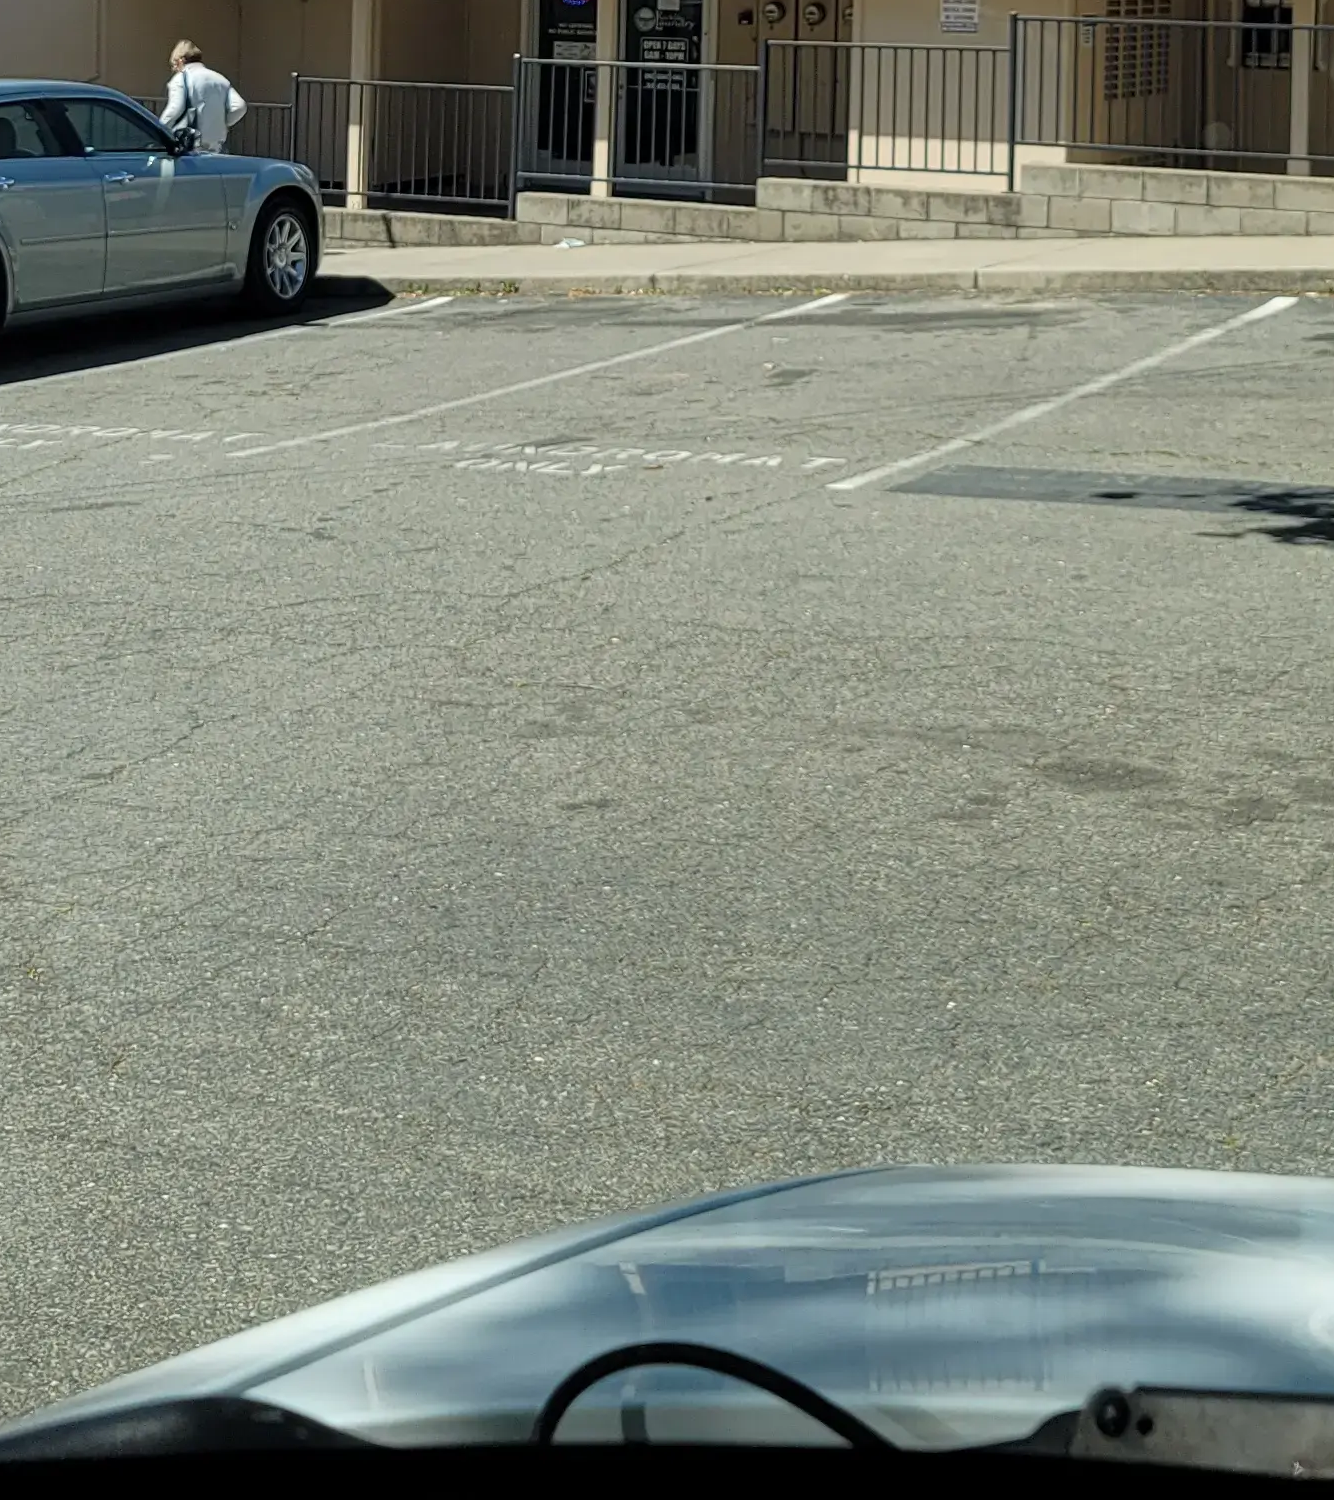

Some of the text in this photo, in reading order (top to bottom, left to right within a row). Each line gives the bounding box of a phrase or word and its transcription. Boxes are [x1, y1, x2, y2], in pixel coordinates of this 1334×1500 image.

[644, 40, 661, 49] OPEN
[373, 441, 848, 468] LAUNDROMAT
[455, 458, 629, 474] ONLY
